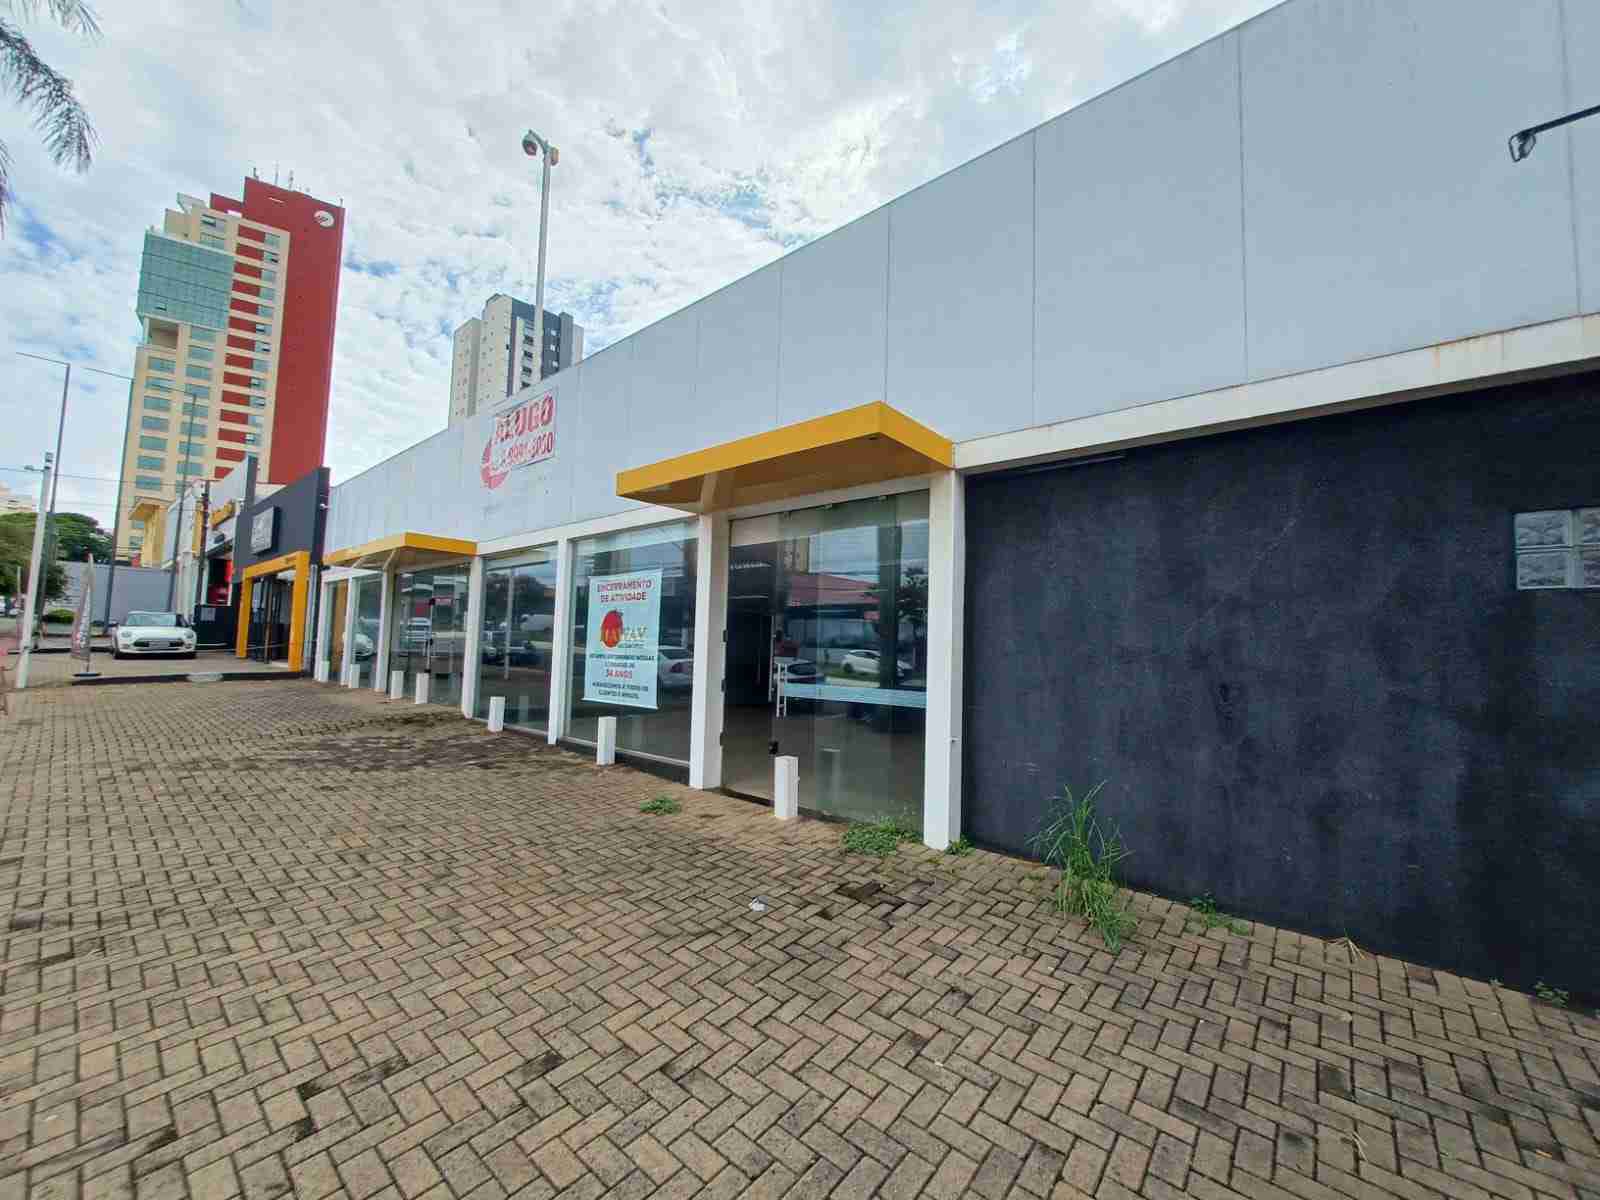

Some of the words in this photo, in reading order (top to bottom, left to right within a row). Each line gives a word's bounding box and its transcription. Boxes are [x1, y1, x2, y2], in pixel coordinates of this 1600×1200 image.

[596, 580, 652, 593] ENCERRAMENTO
[600, 594, 609, 603] DE
[610, 591, 648, 602] ATIVIDADE
